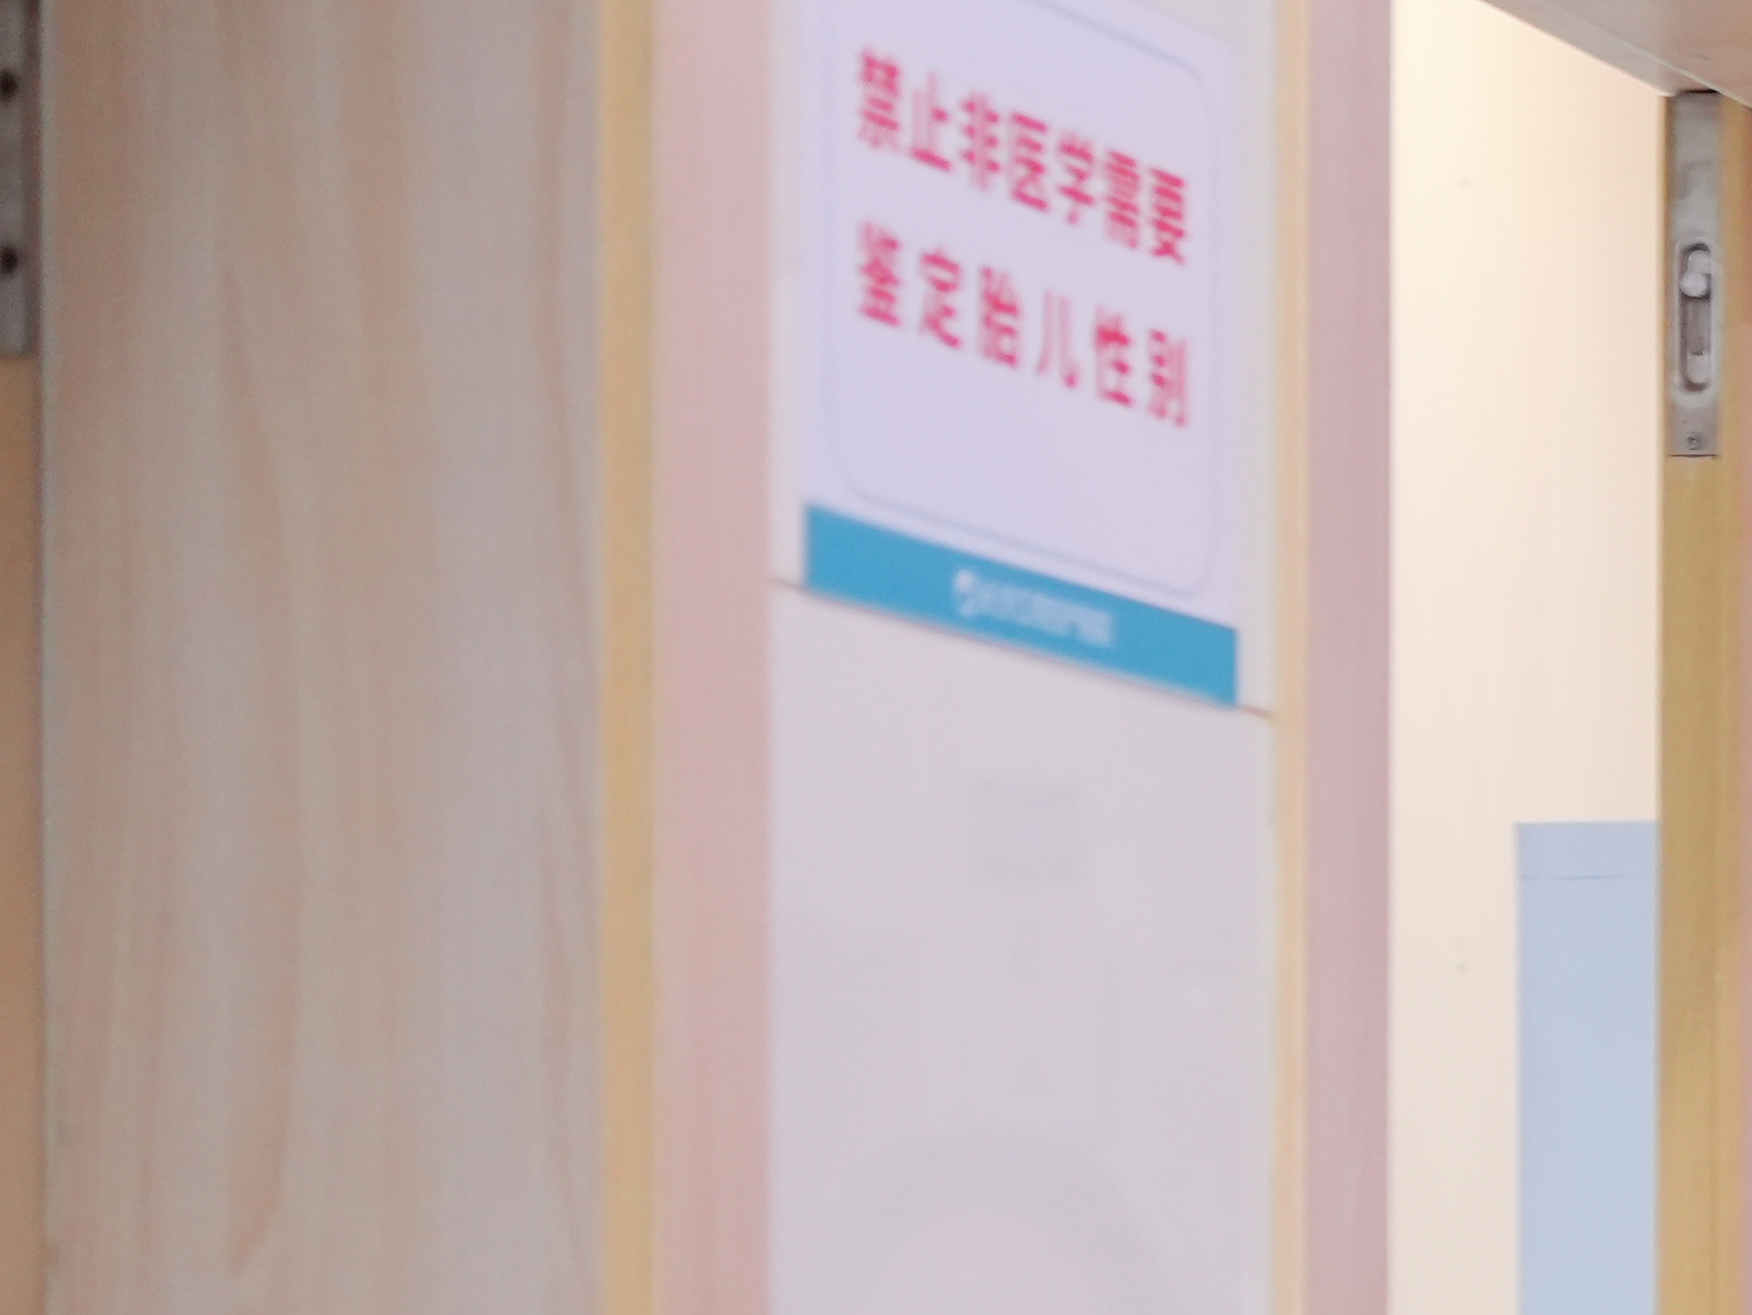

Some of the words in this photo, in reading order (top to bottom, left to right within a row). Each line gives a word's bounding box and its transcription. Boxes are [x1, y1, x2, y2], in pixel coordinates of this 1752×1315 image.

[857, 47, 1187, 266] 禁止非医学需要
[857, 219, 1188, 428] 鉴定胎儿性别
